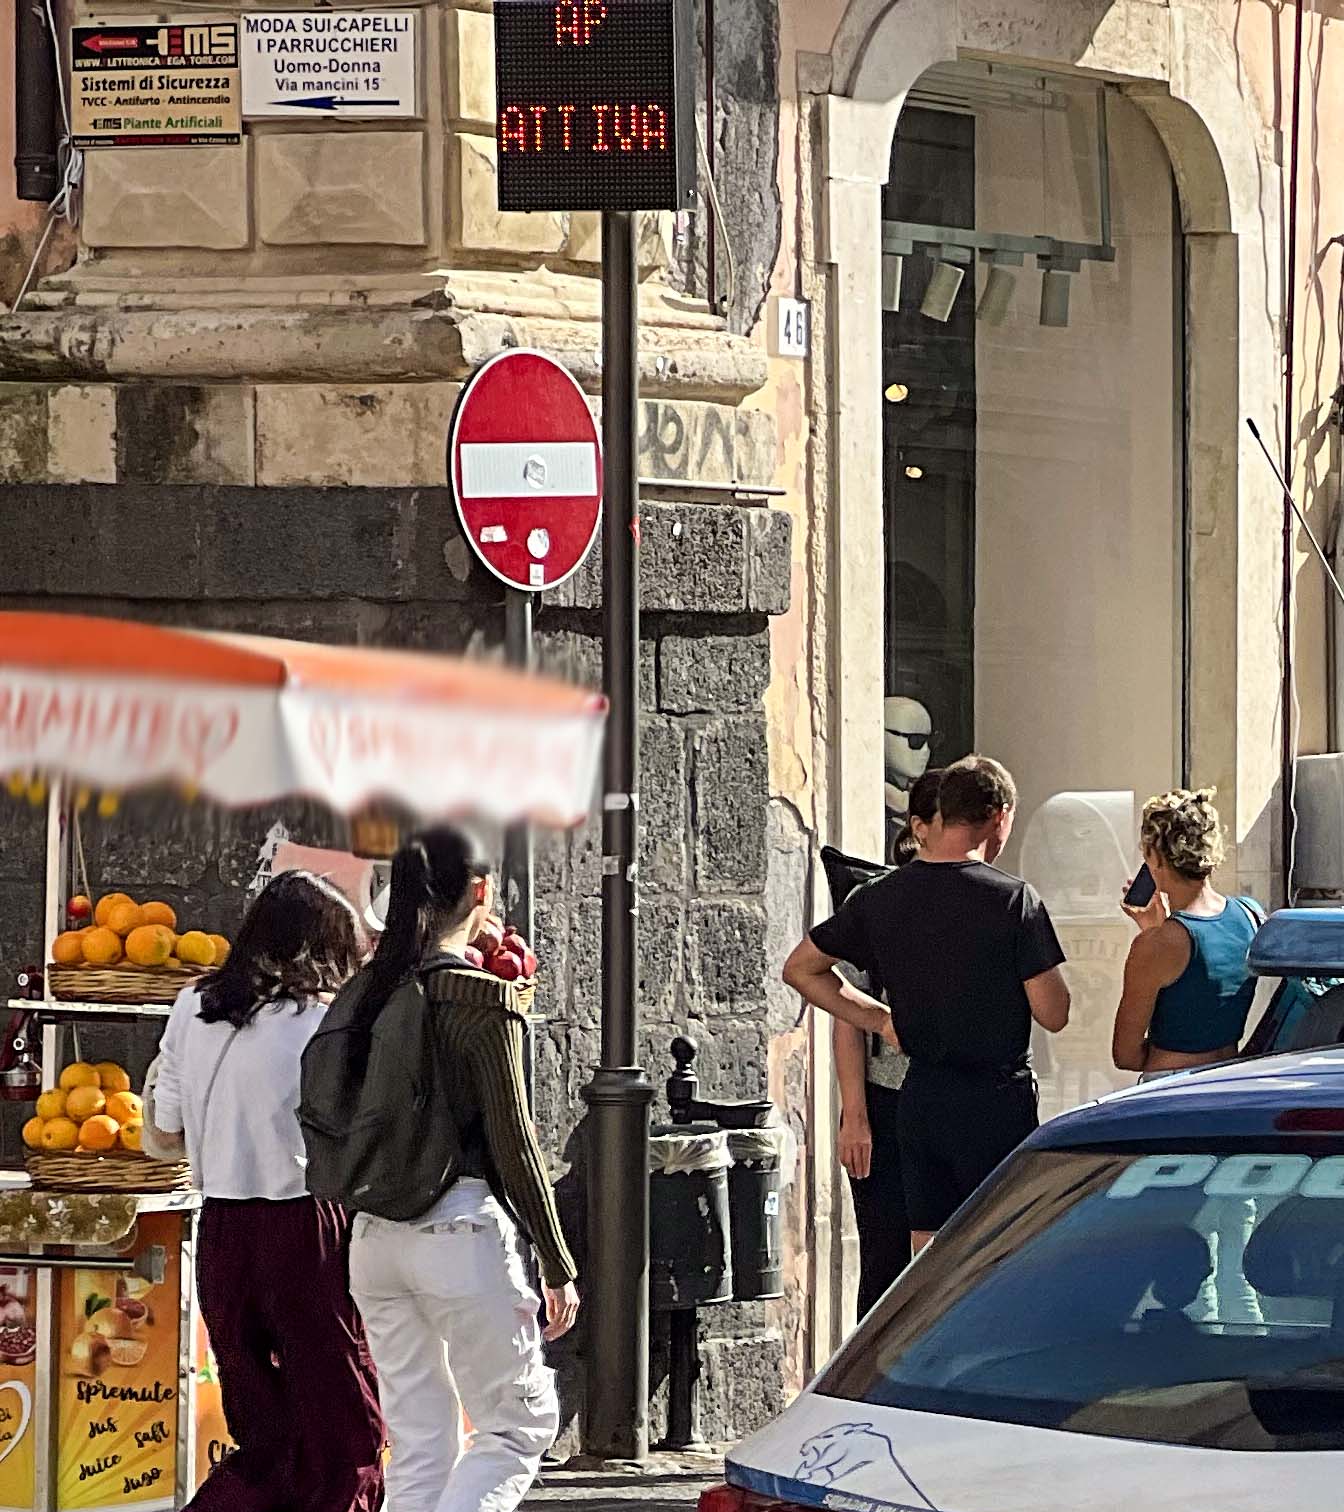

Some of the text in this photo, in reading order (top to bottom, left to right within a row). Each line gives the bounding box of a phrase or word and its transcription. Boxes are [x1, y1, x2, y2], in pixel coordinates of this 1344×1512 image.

[246, 17, 409, 33] MODA SUI CAPELLI
[555, 0, 608, 45] AP
[257, 37, 398, 53] I PARRUCCHIERI
[274, 59, 381, 73] Uomo-Donna
[82, 75, 230, 91] Sistemi di Sicurezza
[275, 77, 380, 91] Via mancini 15
[81, 94, 230, 107] TVCC Antifurto Antincendio
[124, 117, 161, 129] Piante
[165, 116, 223, 128] Artificiali
[501, 104, 667, 152] ATTIVA
[784, 309, 803, 345] 46
[77, 1381, 177, 1403] Spremute
